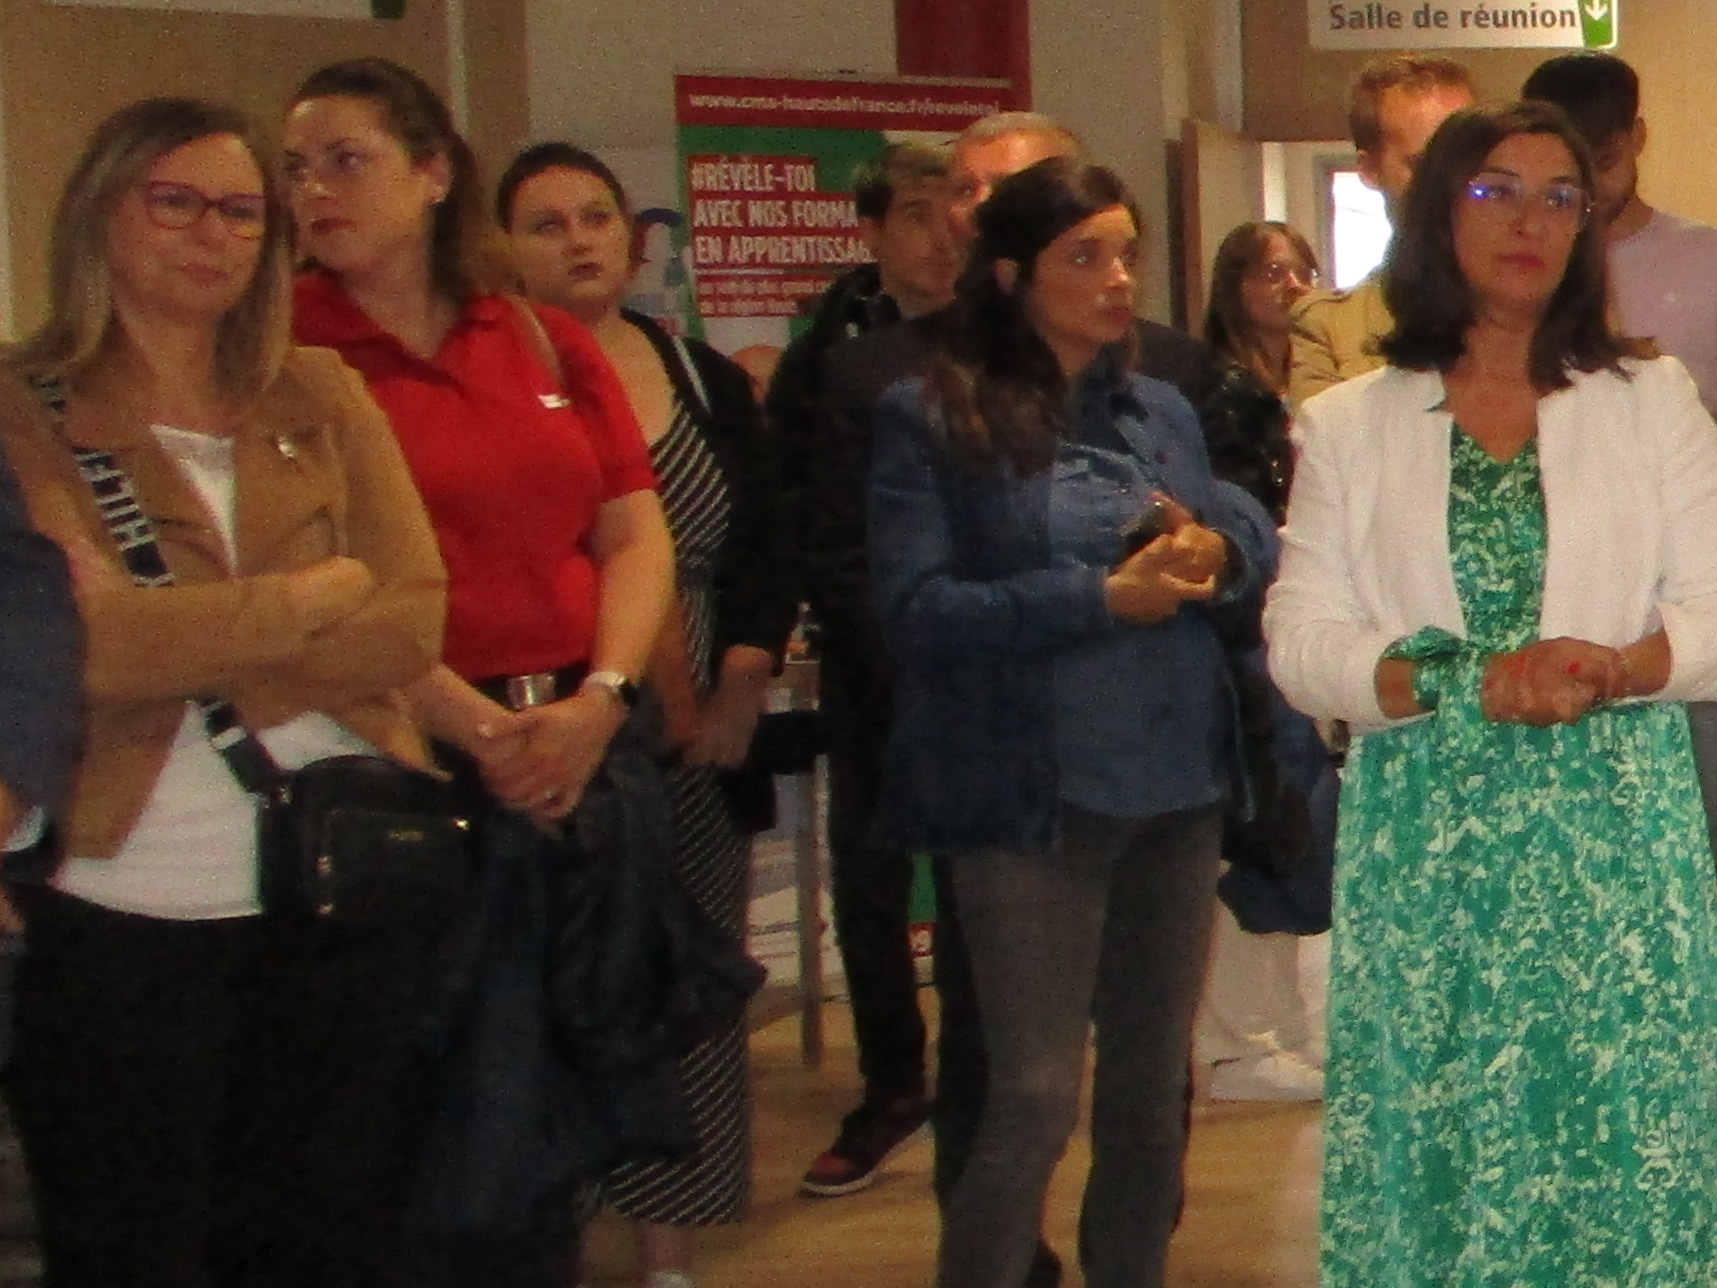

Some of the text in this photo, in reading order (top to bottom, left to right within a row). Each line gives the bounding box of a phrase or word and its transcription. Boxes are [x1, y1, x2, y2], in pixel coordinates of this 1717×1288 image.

[1329, 2, 1577, 31] Salle de réunion
[694, 200, 859, 228] AVEC NOS FORMA
[695, 236, 722, 263] EN
